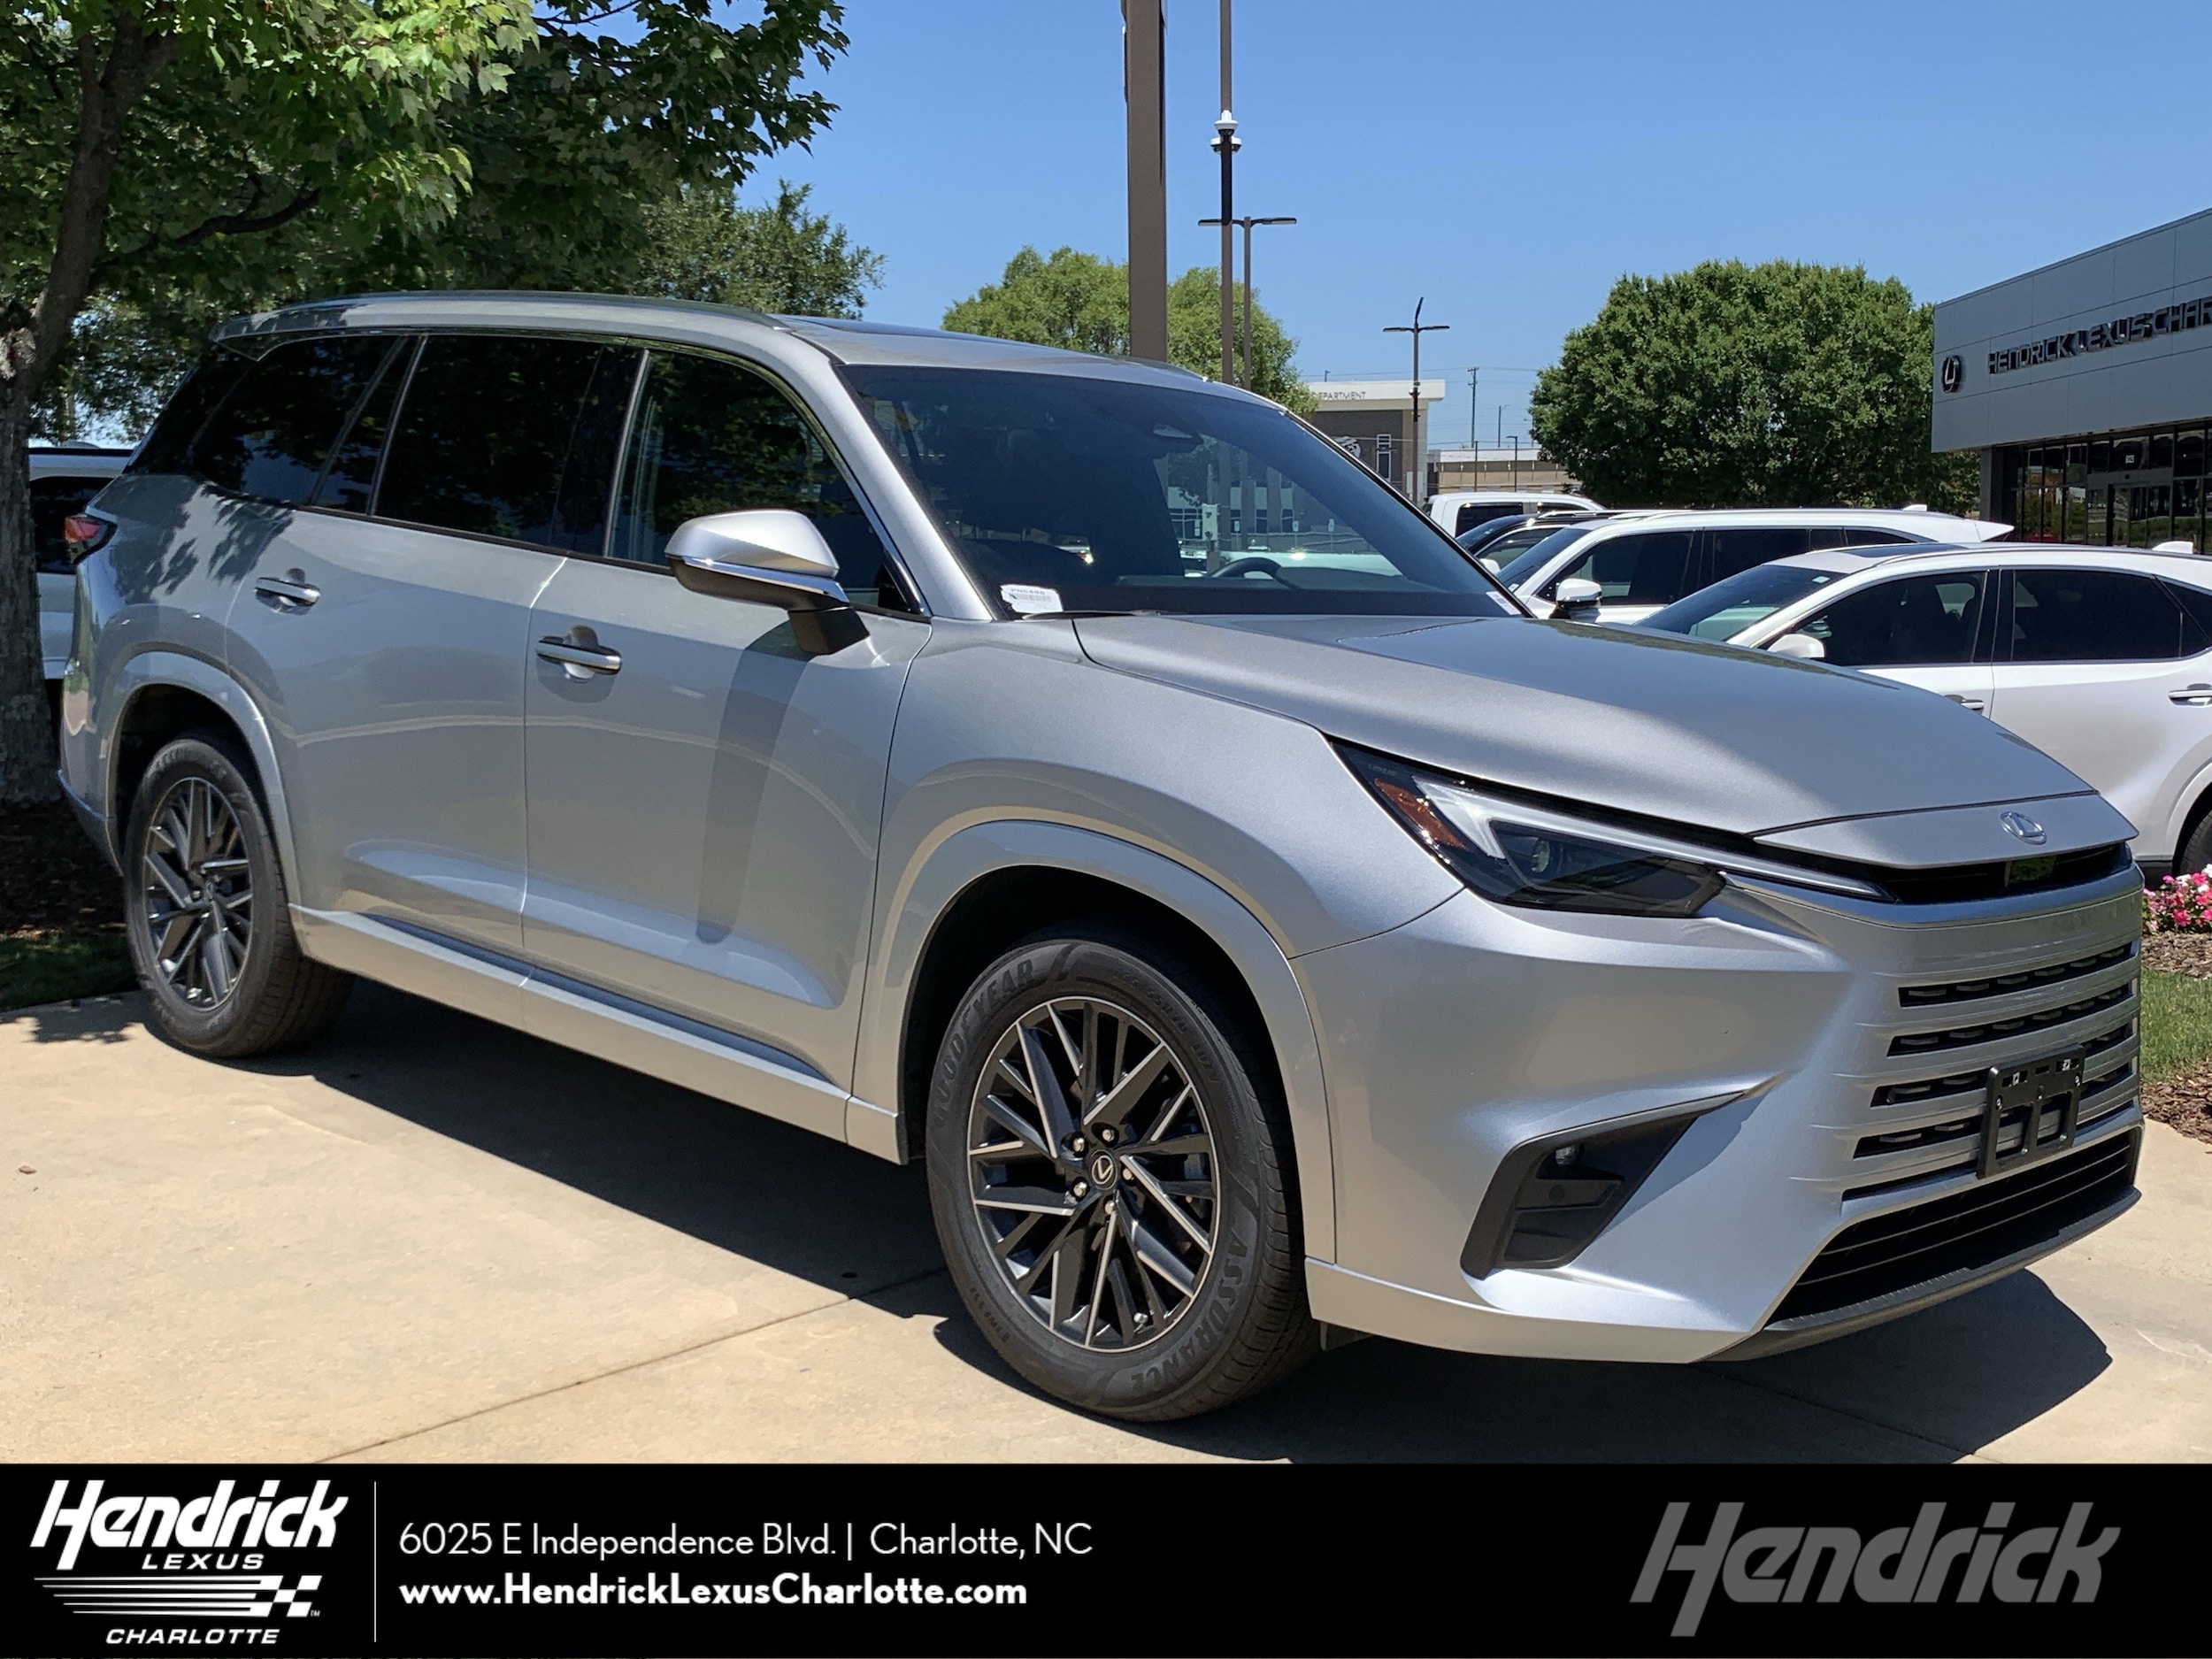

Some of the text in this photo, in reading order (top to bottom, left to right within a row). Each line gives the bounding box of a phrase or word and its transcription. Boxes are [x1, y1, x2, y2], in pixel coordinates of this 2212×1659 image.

[1987, 333, 2076, 374] HENDRICK
[2076, 313, 2153, 353] LEXUS
[1130, 1227, 1248, 1394] ASSURANCE
